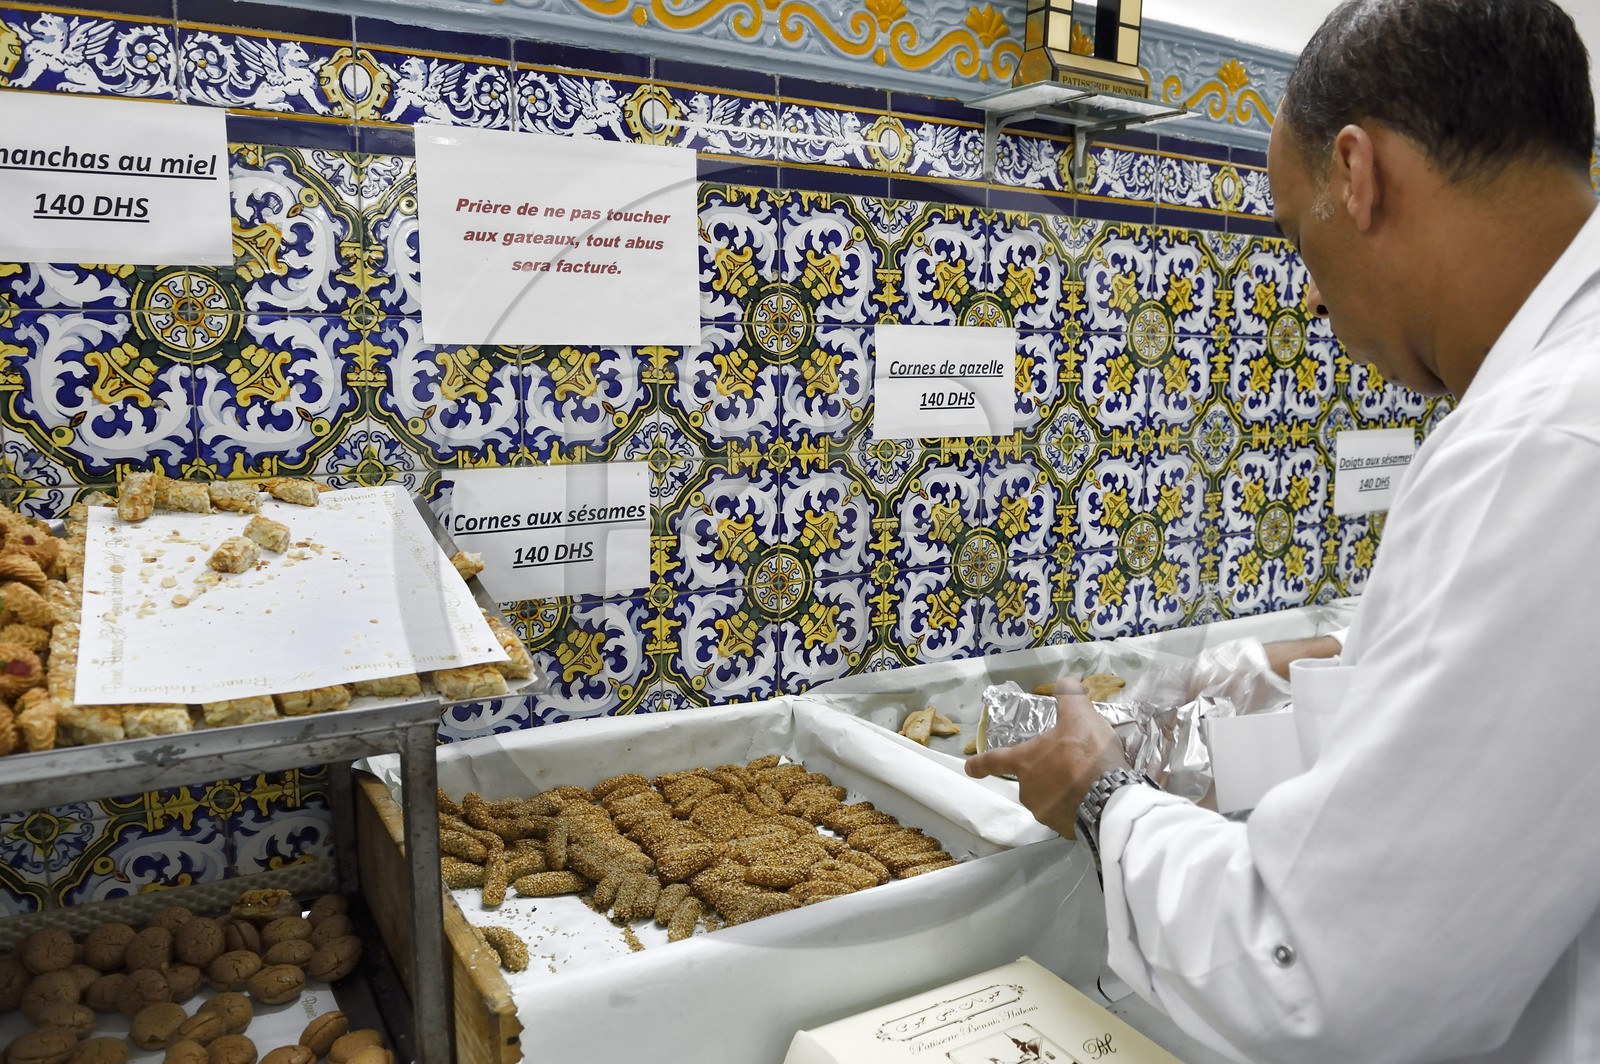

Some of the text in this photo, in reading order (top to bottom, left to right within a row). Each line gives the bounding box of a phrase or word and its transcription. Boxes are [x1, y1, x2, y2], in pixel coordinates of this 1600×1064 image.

[118, 155, 152, 171] au
[160, 155, 217, 176] miel
[34, 194, 149, 218] 140 DHS
[455, 198, 671, 225] Prière de ne pas toucher
[463, 230, 664, 250] aux gateaux, tout abus
[511, 259, 622, 275] sera facturé.
[889, 360, 1004, 377] Cornes de gazelle
[920, 392, 976, 407] 140 DHS
[1340, 456, 1364, 469] Doigts
[1366, 458, 1380, 466] aux
[1360, 476, 1390, 490] 140 DHS
[454, 504, 646, 532] Cornes aux sésames
[513, 541, 594, 565] 140 DHS
